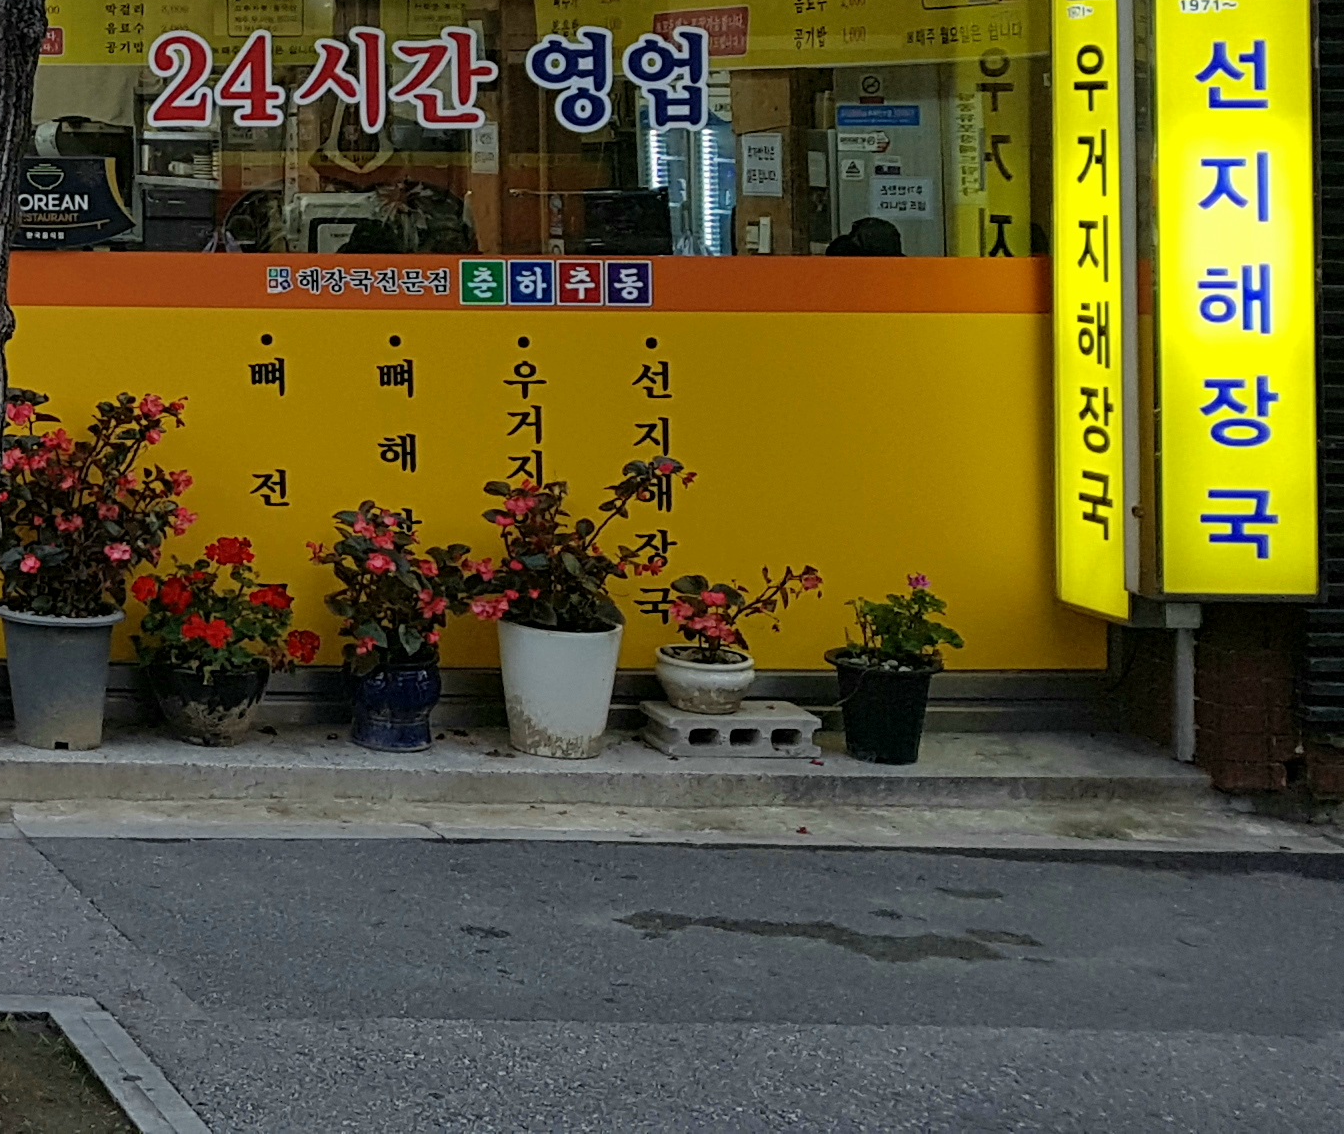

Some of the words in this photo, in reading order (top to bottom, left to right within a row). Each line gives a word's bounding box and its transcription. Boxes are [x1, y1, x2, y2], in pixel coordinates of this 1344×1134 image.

[1179, 0, 1237, 11] 1971~
[147, 26, 499, 133] 24시간
[526, 25, 710, 133] 영업
[17, 193, 89, 212] OREAN
[23, 213, 80, 223] STAURANT
[297, 268, 451, 296] 해장국전문점
[1194, 39, 1280, 560] 선지해장국
